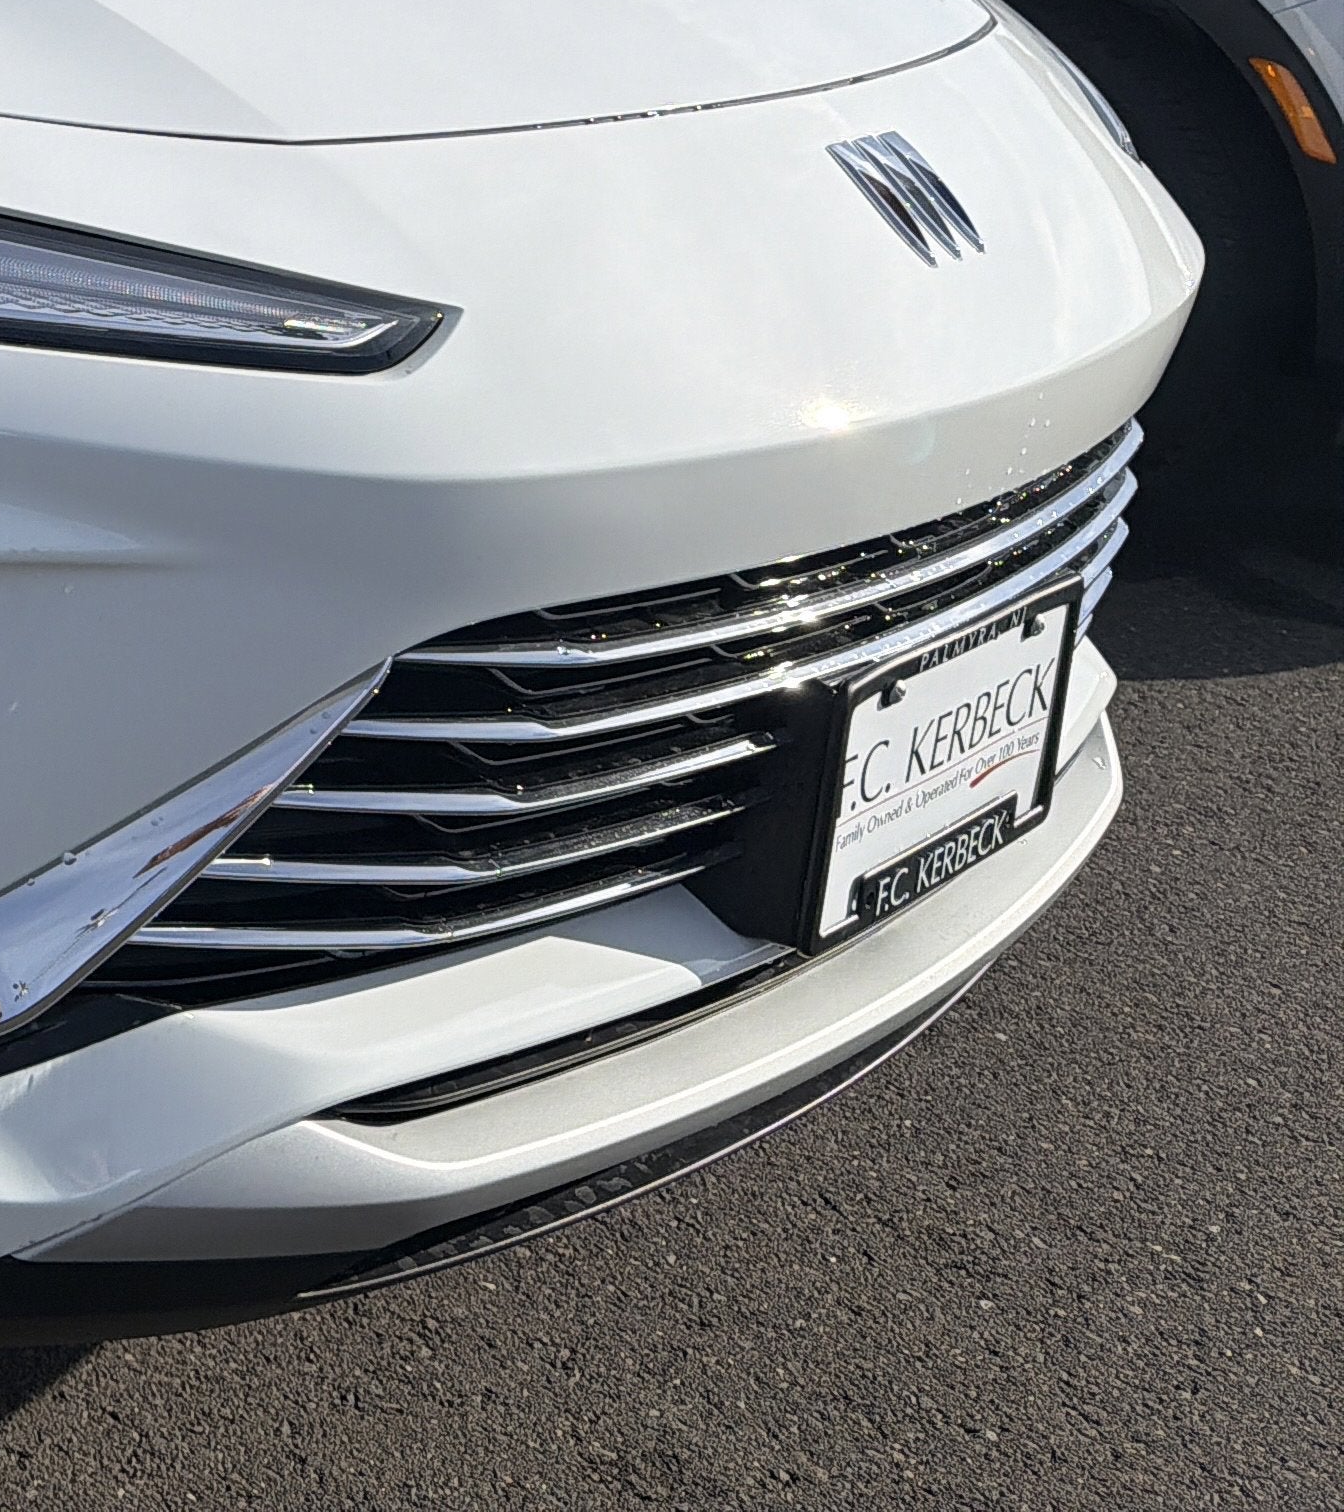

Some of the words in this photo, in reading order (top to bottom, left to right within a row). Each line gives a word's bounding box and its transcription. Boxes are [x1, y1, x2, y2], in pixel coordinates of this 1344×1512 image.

[905, 657, 1056, 783] KERBECK
[836, 826, 866, 852] Family
[867, 805, 903, 834] Owned
[904, 800, 913, 815] &
[916, 776, 959, 810] Operated
[959, 767, 973, 786] For
[975, 753, 996, 775] Over
[998, 741, 1015, 763] 100
[1017, 732, 1041, 753] Years
[876, 867, 910, 916] F.C.
[916, 809, 1008, 893] KERBECK
